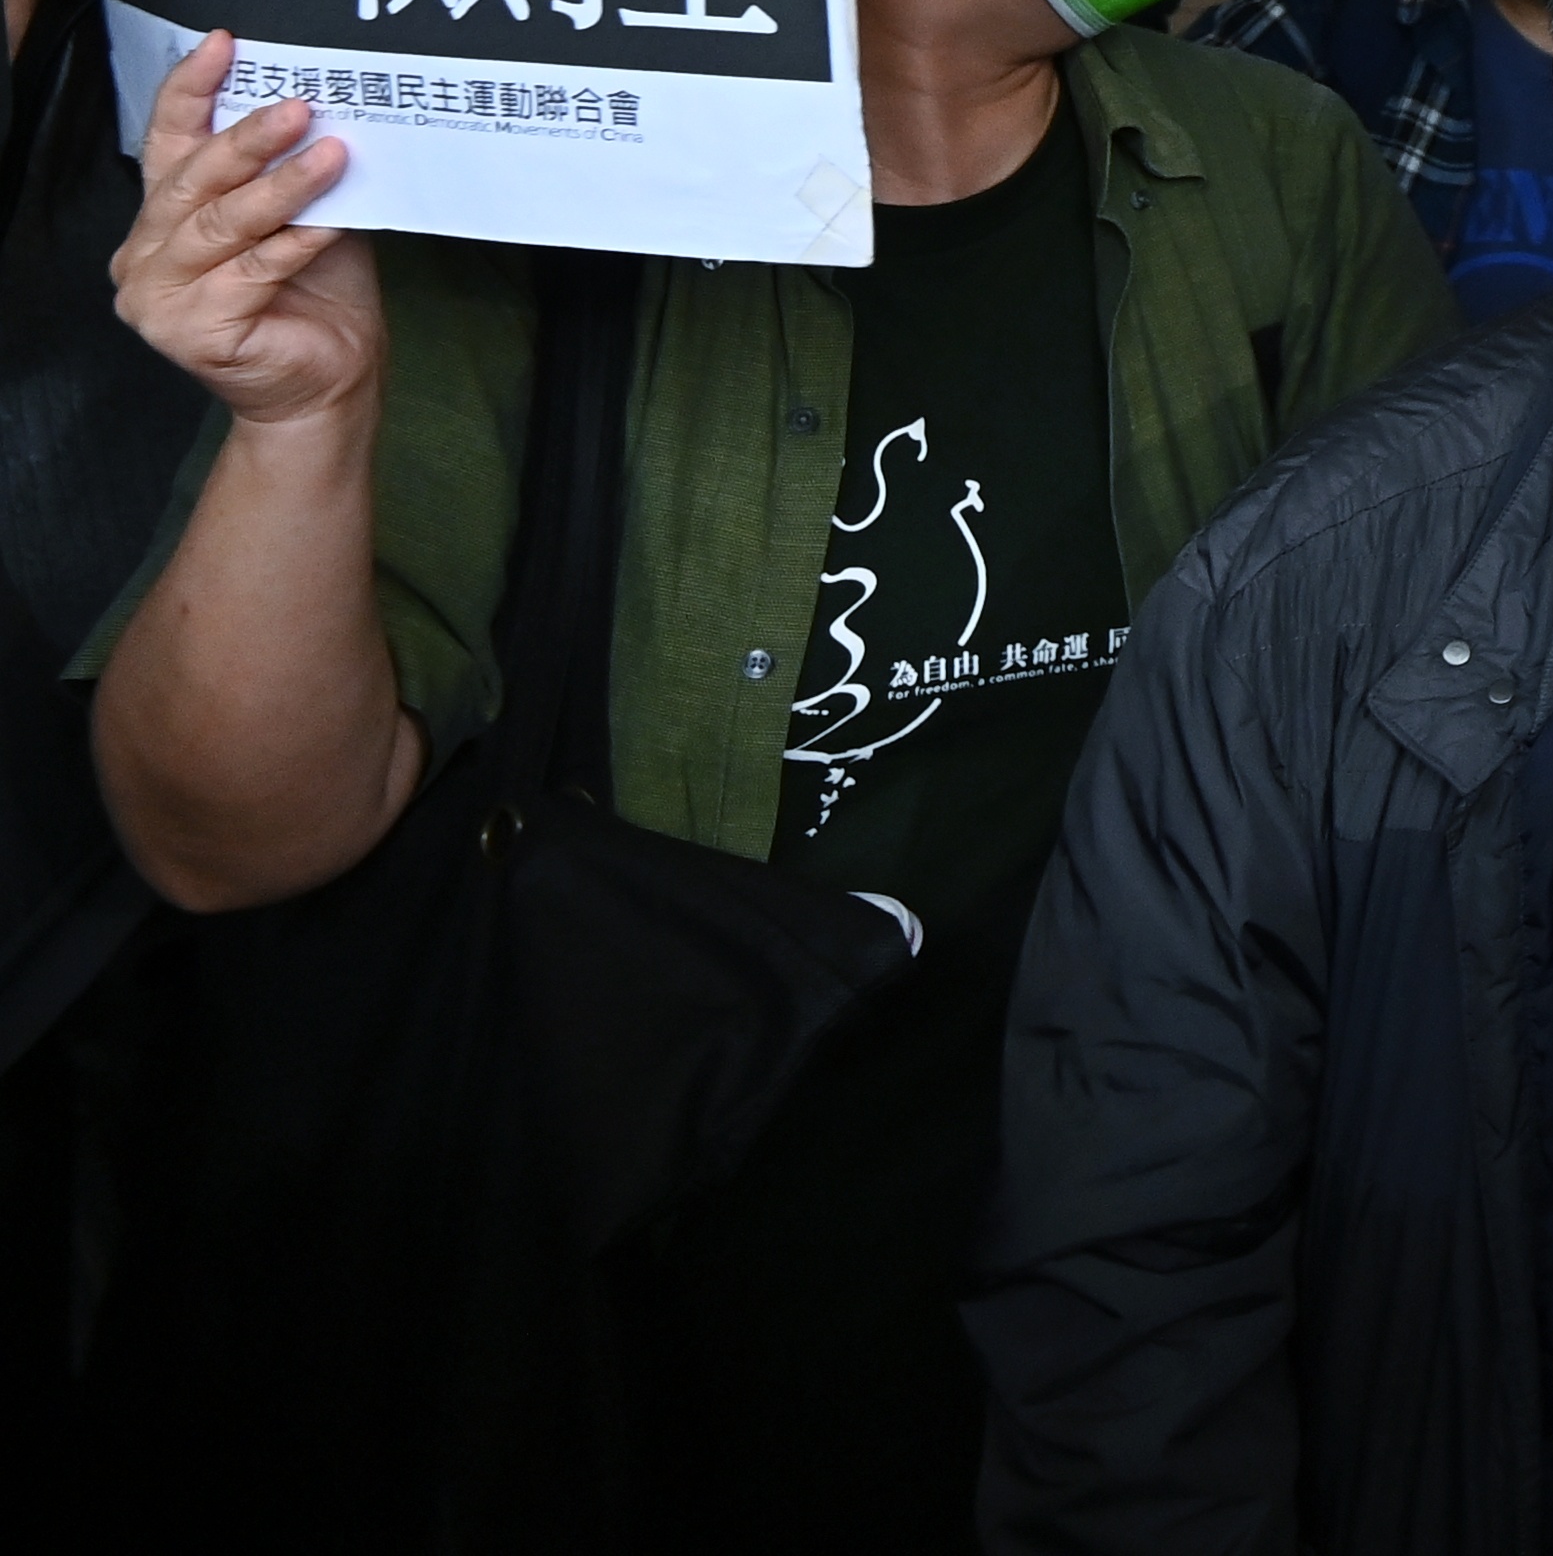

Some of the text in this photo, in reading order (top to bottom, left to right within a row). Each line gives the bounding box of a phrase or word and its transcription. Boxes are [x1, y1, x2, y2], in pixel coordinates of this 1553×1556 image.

[889, 650, 980, 688] 為自由
[1000, 632, 1090, 672] 共命運
[887, 690, 910, 701] For
[989, 667, 1044, 684] common
